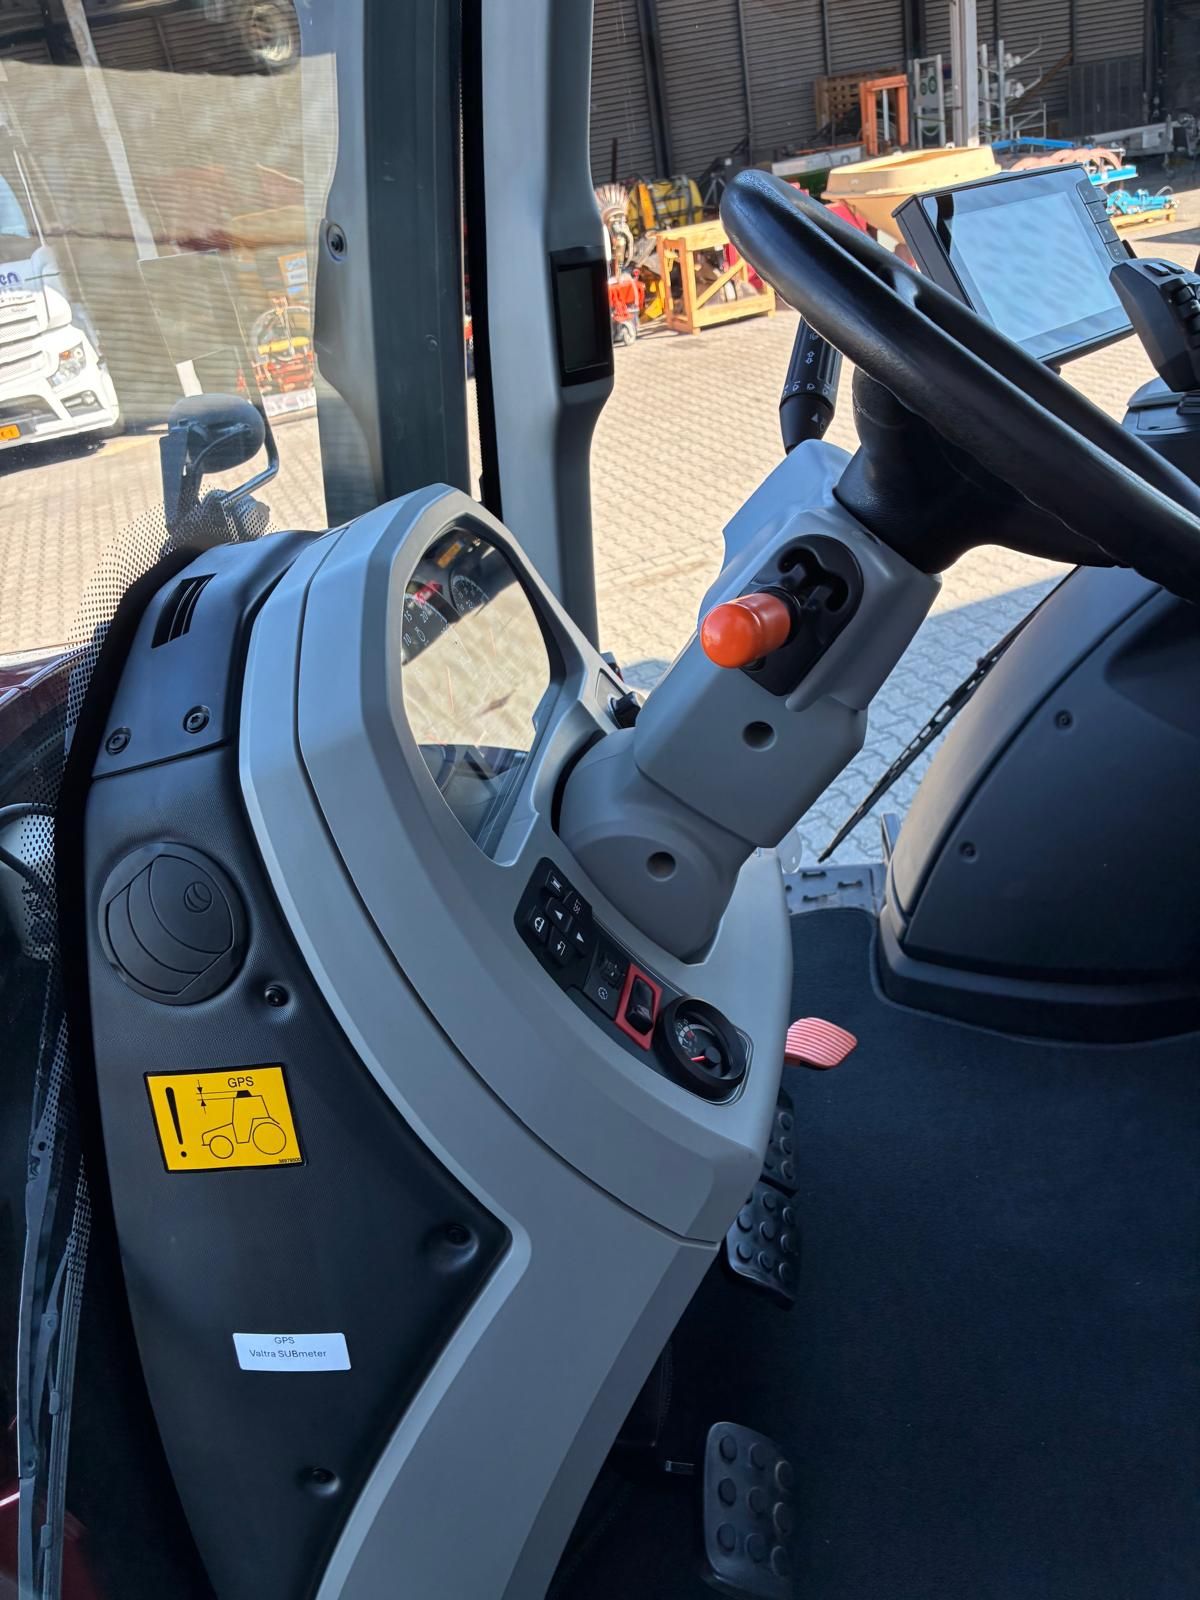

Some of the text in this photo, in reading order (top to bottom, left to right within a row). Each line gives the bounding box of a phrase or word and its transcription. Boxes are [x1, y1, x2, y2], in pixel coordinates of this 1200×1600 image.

[227, 1076, 254, 1088] GPS
[274, 1336, 295, 1344] GPS
[249, 1349, 327, 1358] Valtra SUBmeter
